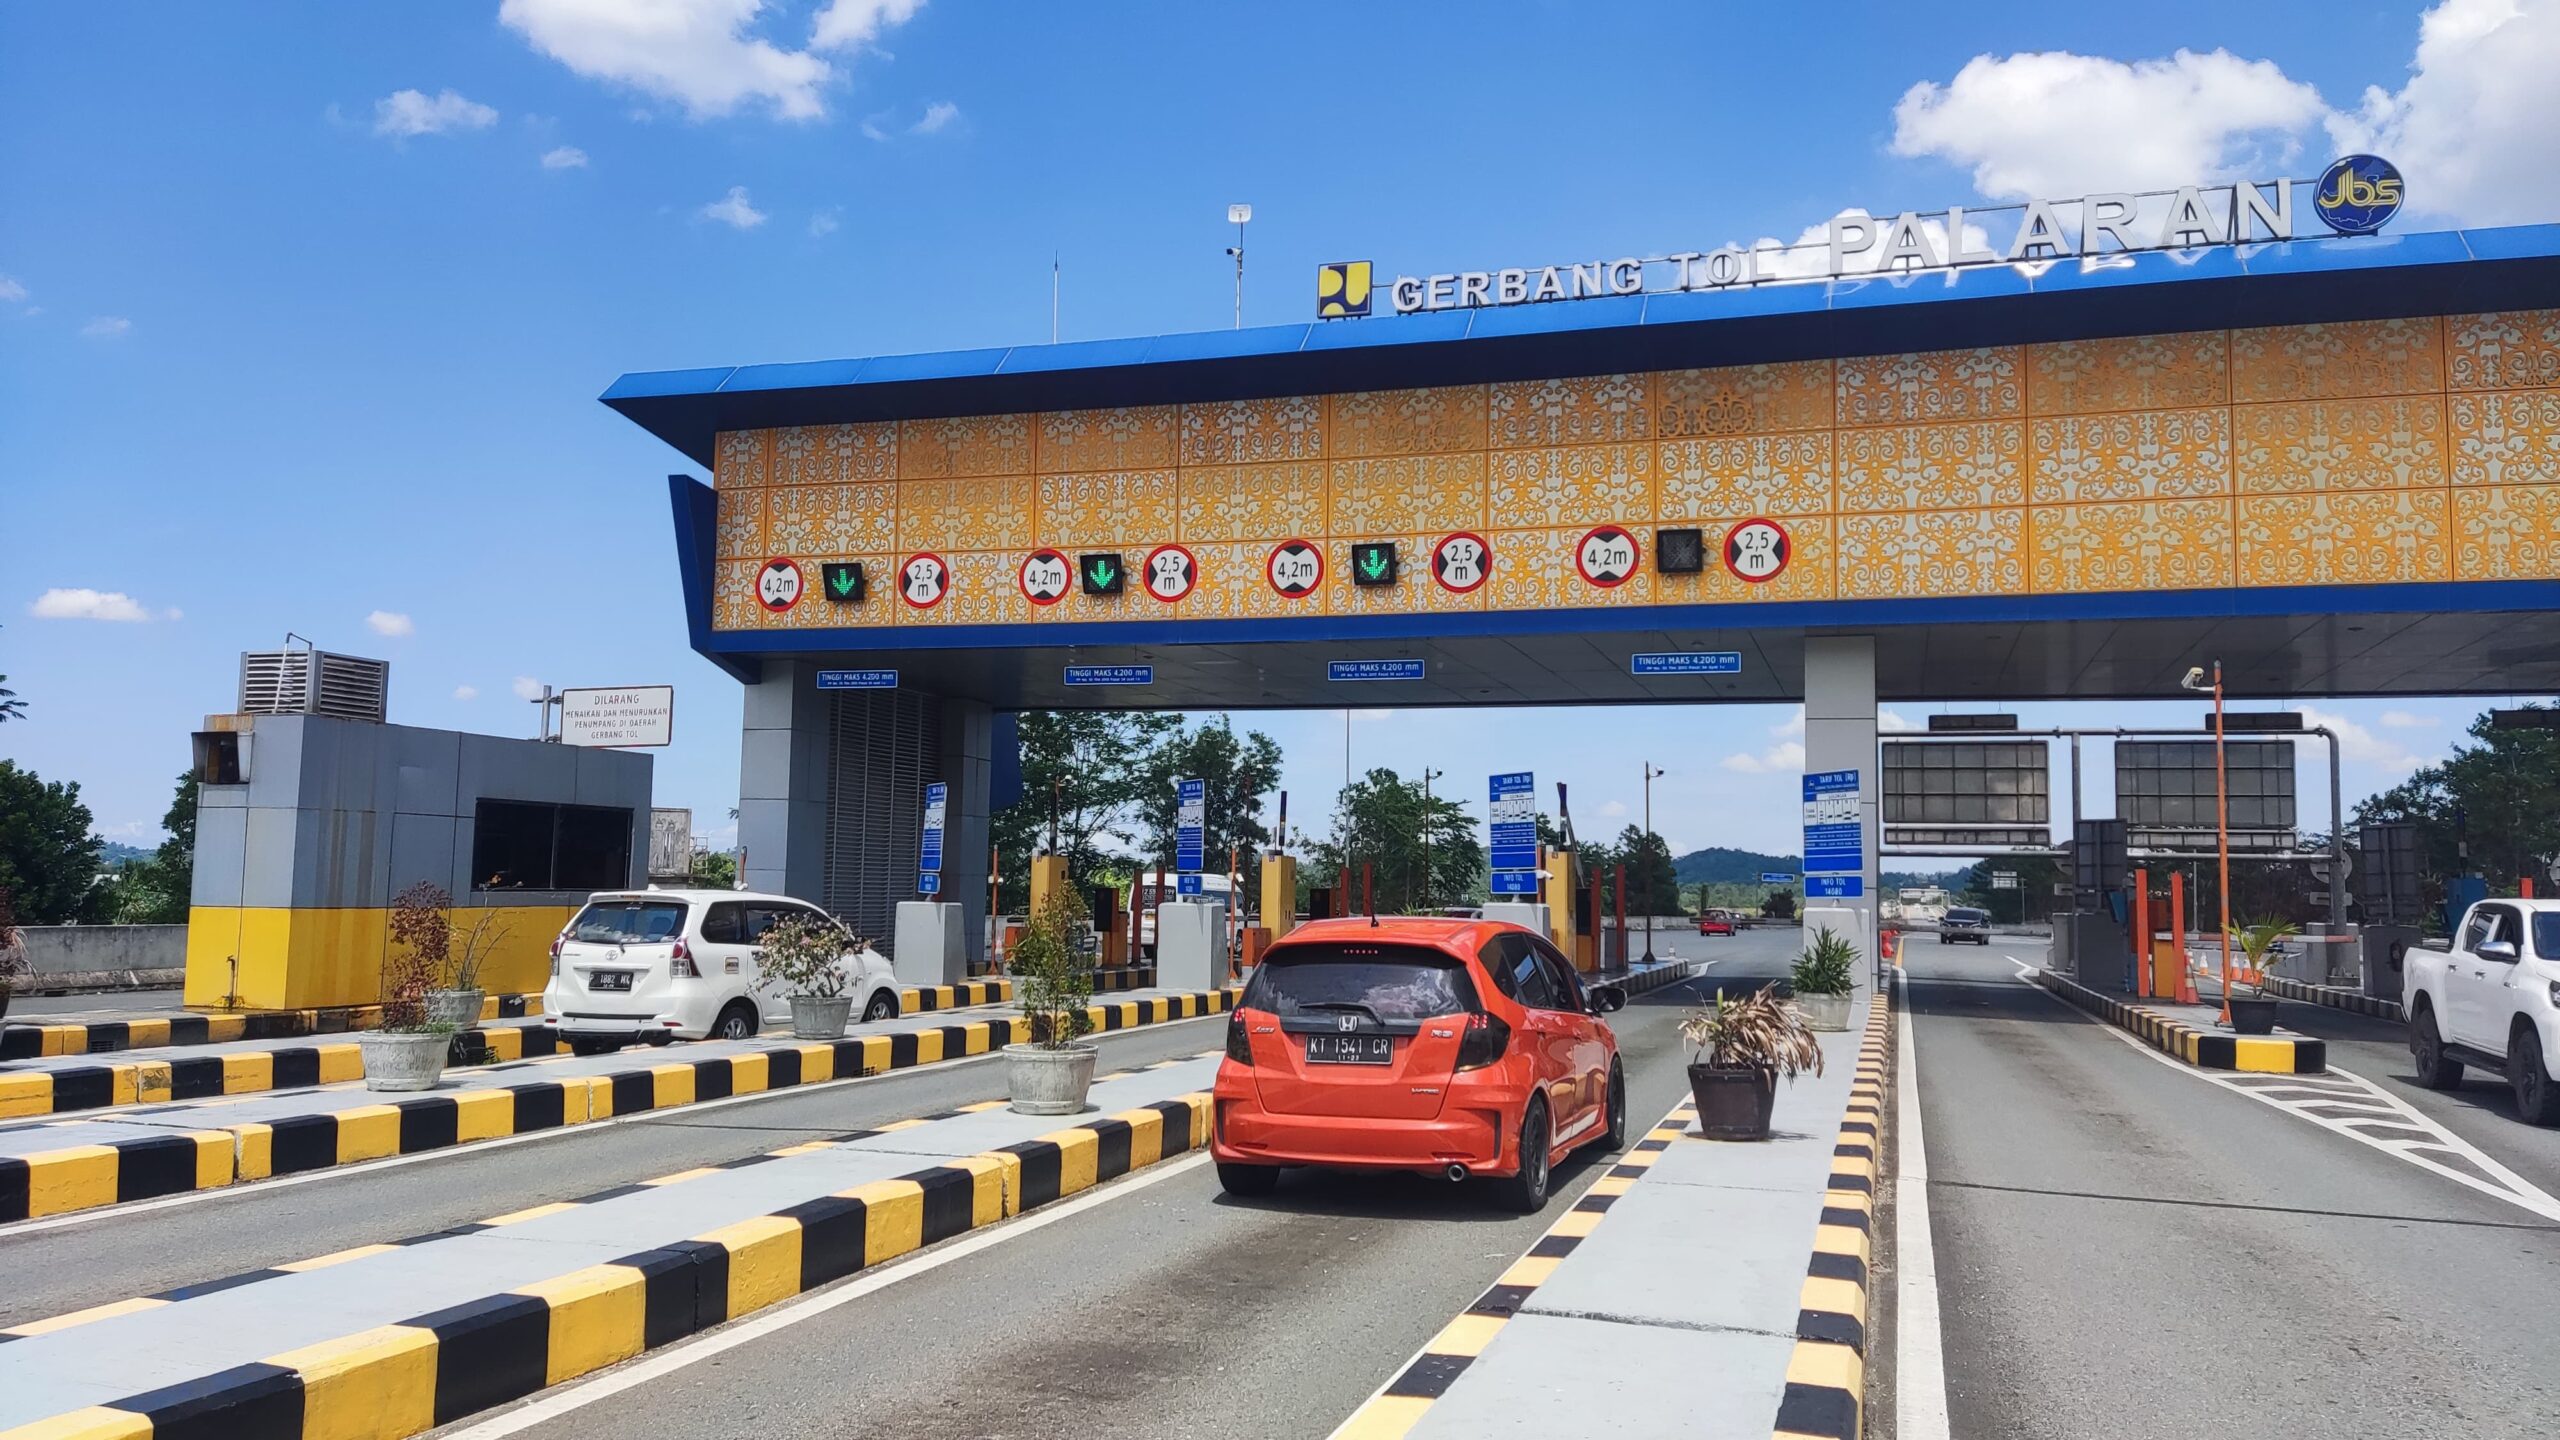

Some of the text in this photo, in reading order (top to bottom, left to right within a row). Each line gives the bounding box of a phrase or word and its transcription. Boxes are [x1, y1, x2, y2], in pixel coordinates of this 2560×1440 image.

[1829, 177, 2293, 276] PALARAN
[1391, 243, 1776, 313] GERBANG TOL
[1745, 531, 1769, 551] 2,5
[1450, 544, 1473, 564] 2,5
[1588, 548, 1627, 569] 4,2m
[1159, 556, 1180, 575] 2,5
[1749, 554, 1764, 569] m
[914, 564, 933, 582] 2,5
[1277, 561, 1313, 581] 4,2m
[1454, 566, 1468, 580] m
[1028, 569, 1062, 588] 4,2m
[1163, 576, 1176, 590] m
[764, 577, 794, 595] 4,2m
[917, 583, 929, 597] m
[1638, 655, 1735, 665] TINGGI MAKS 4.200 mm
[1069, 669, 1092, 677] TINGGI
[1093, 669, 1112, 677] MAKS
[1333, 664, 1358, 672] TINGGI
[1359, 663, 1380, 671] MAKS
[1381, 663, 1402, 671] 4.200
[843, 673, 861, 681] MAKS
[594, 694, 640, 705] DILARANG
[565, 707, 668, 718] MENAIKAN DAN MENURUNKAN
[574, 718, 657, 729] PENUMPANG DI DAERAH
[591, 729, 639, 739] GERBANG TOL
[1834, 774, 1843, 782] TOL
[1820, 878, 1846, 886] INFO TOL
[1310, 1037, 1389, 1055] KT 1541 CR
